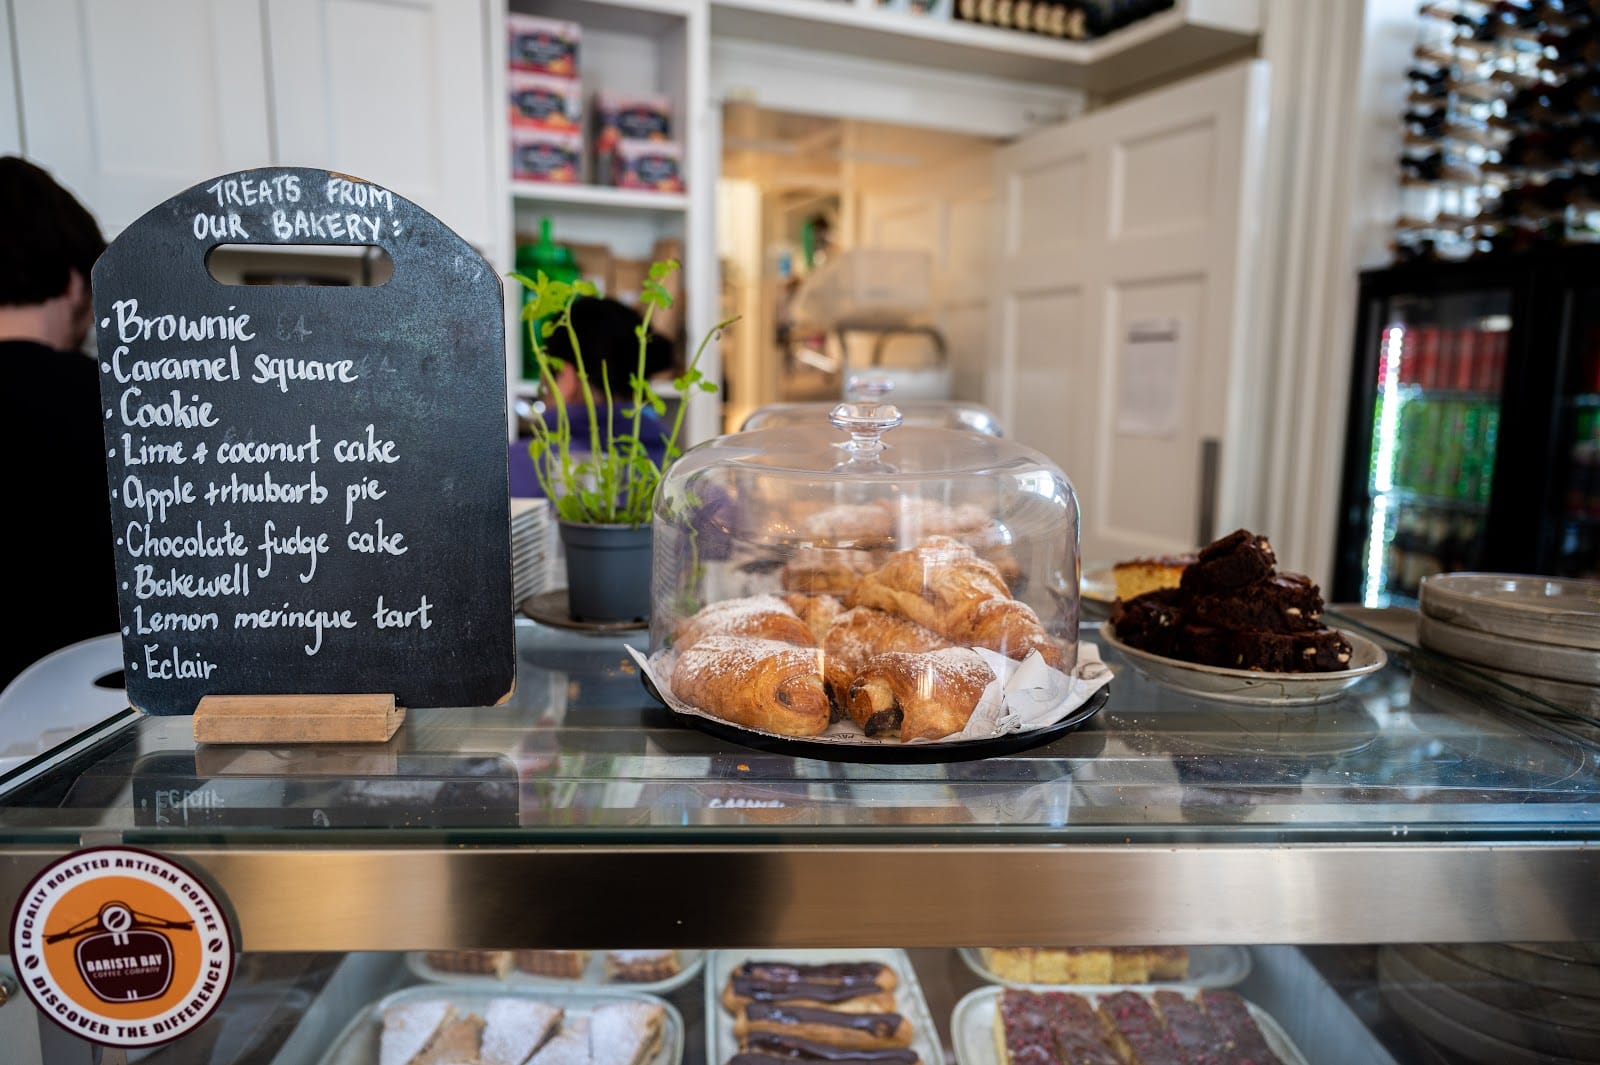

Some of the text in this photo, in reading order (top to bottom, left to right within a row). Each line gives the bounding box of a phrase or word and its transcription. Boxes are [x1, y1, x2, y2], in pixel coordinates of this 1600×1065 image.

[207, 174, 394, 212] TREATS FROM
[193, 213, 250, 240] OUR
[112, 299, 256, 343] Brownie
[112, 346, 241, 383] Caramel
[120, 387, 220, 429] Cookie
[122, 432, 188, 467] Lime
[217, 424, 321, 464] coconut
[333, 423, 400, 464] cake
[346, 476, 387, 525] pie
[126, 518, 408, 584] Chocolate fudge cake
[134, 563, 250, 600] Bakewell
[133, 595, 434, 657] Lemon meringue tart
[144, 644, 218, 681] Eclair
[22, 858, 218, 949] LOCALLY ROASTED ARTISAN COFFEE
[86, 954, 162, 972] BARISTA BAY
[93, 969, 121, 979] COFFEE
[32, 959, 223, 1038] DISCOVER THE DIFFERENCE
